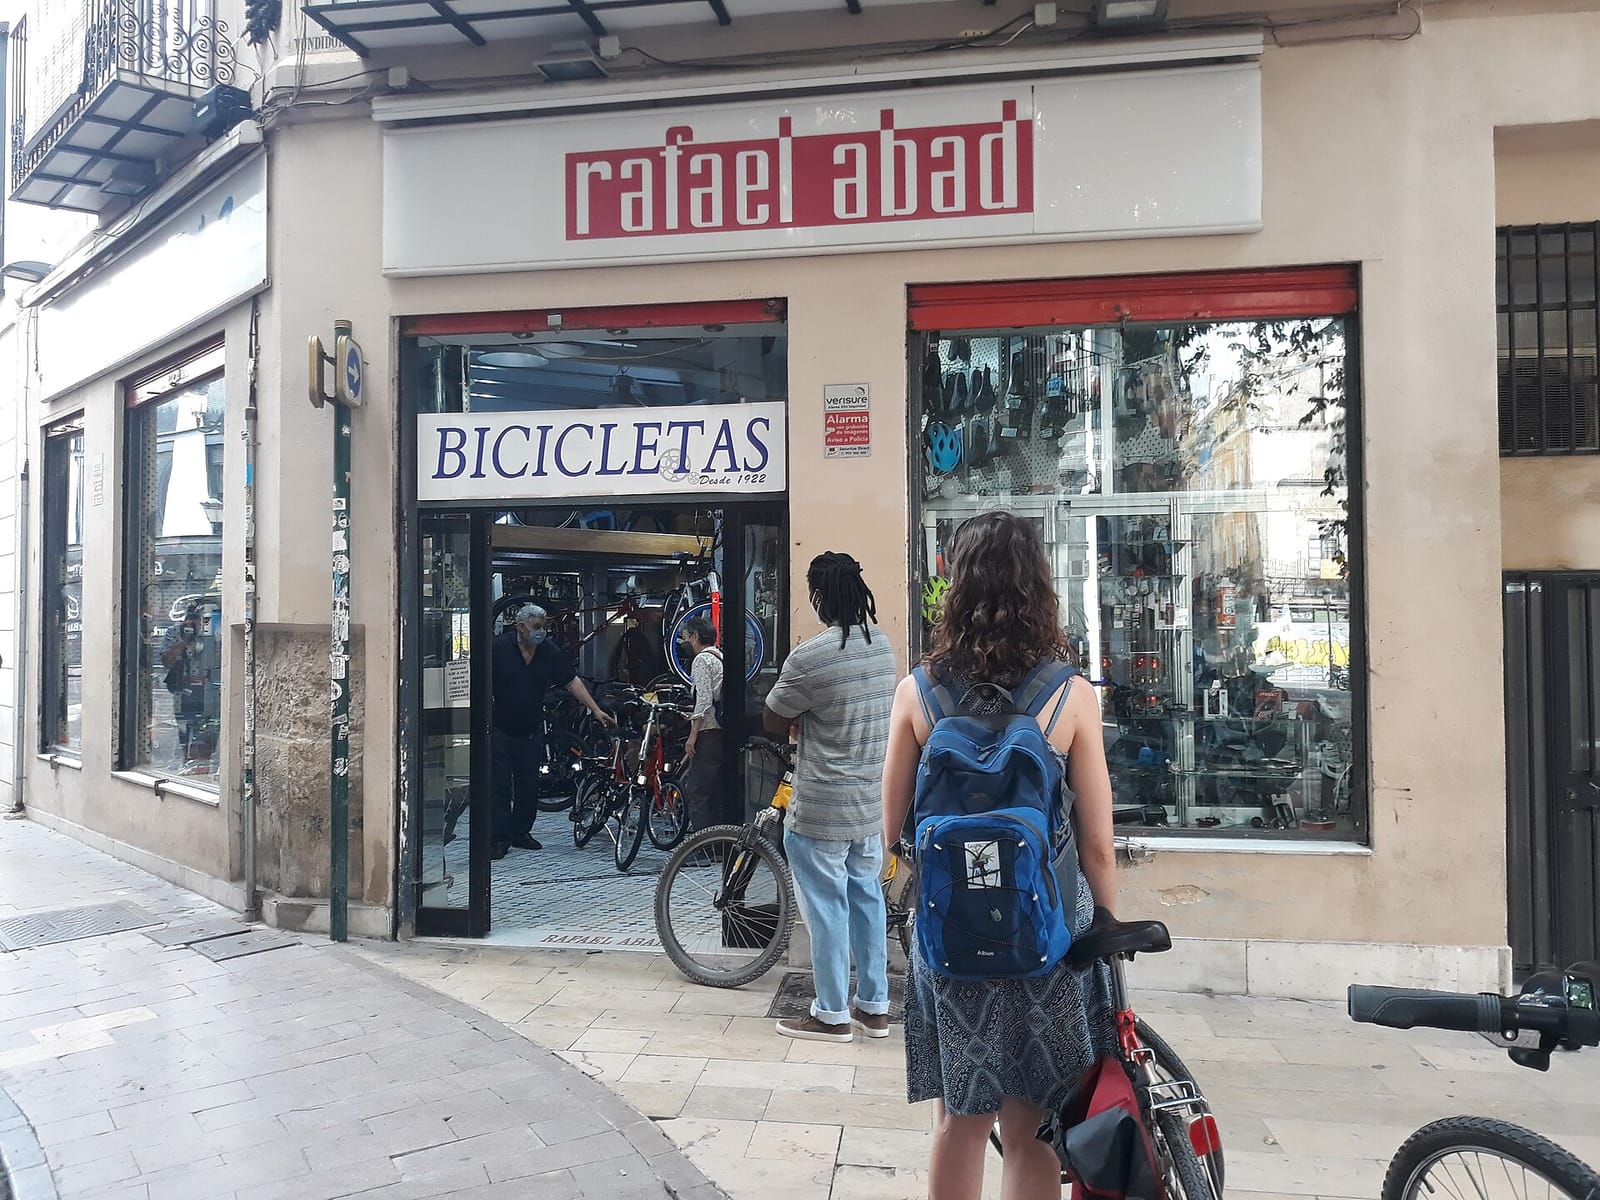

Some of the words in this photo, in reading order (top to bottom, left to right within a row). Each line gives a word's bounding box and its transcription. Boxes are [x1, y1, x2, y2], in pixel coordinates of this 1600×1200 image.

[576, 116, 793, 235] rafael
[833, 99, 1018, 219] abad
[826, 396, 868, 404] verisure
[827, 414, 868, 424] Alarma
[432, 417, 770, 479] BICICLETAS
[699, 475, 731, 485] Desde
[737, 473, 767, 484] 1922
[540, 934, 613, 944] RAFAEL
[616, 937, 662, 946] ABA
